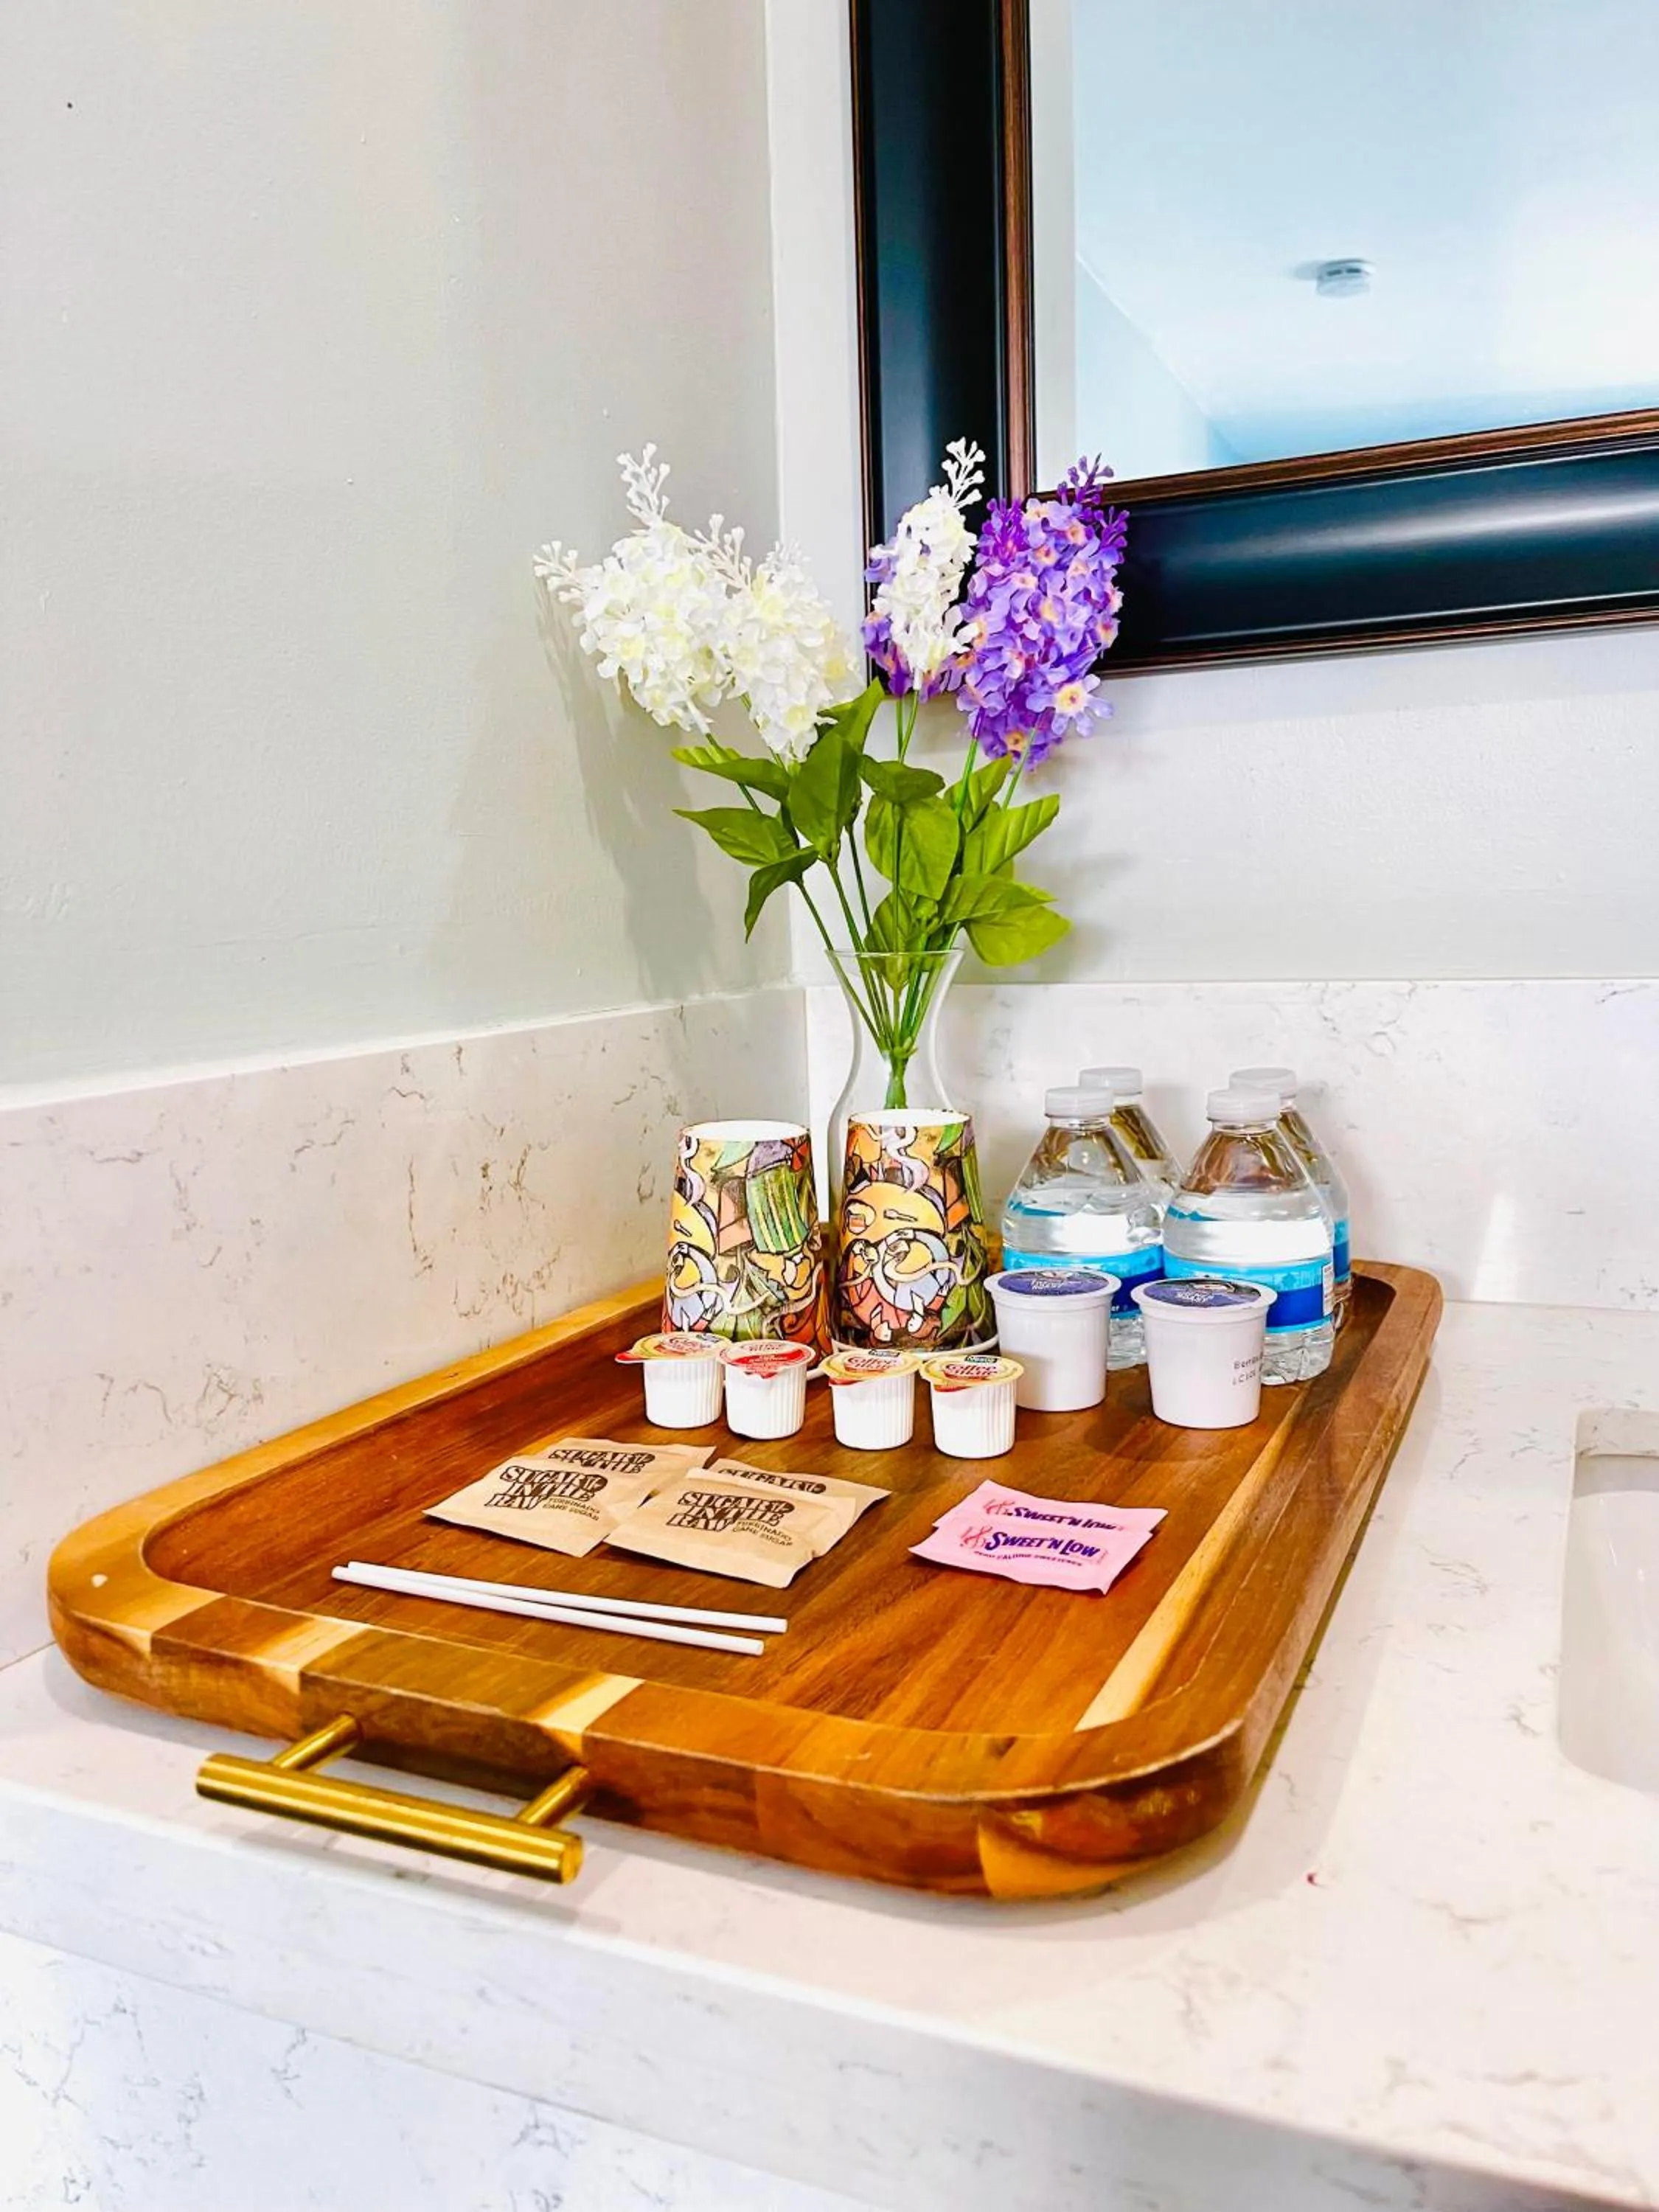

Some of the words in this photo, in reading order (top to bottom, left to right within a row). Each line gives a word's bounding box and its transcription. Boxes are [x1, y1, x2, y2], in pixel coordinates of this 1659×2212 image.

[548, 1449, 655, 1464] SUGAR
[499, 1465, 608, 1492] SUGAR
[484, 1493, 547, 1510] RAW
[506, 1481, 540, 1497] IN
[538, 1481, 595, 1502] THE
[677, 1490, 796, 1514] SUGAR
[666, 1513, 734, 1533] RAW
[685, 1505, 721, 1520] IN
[720, 1506, 785, 1527] THE
